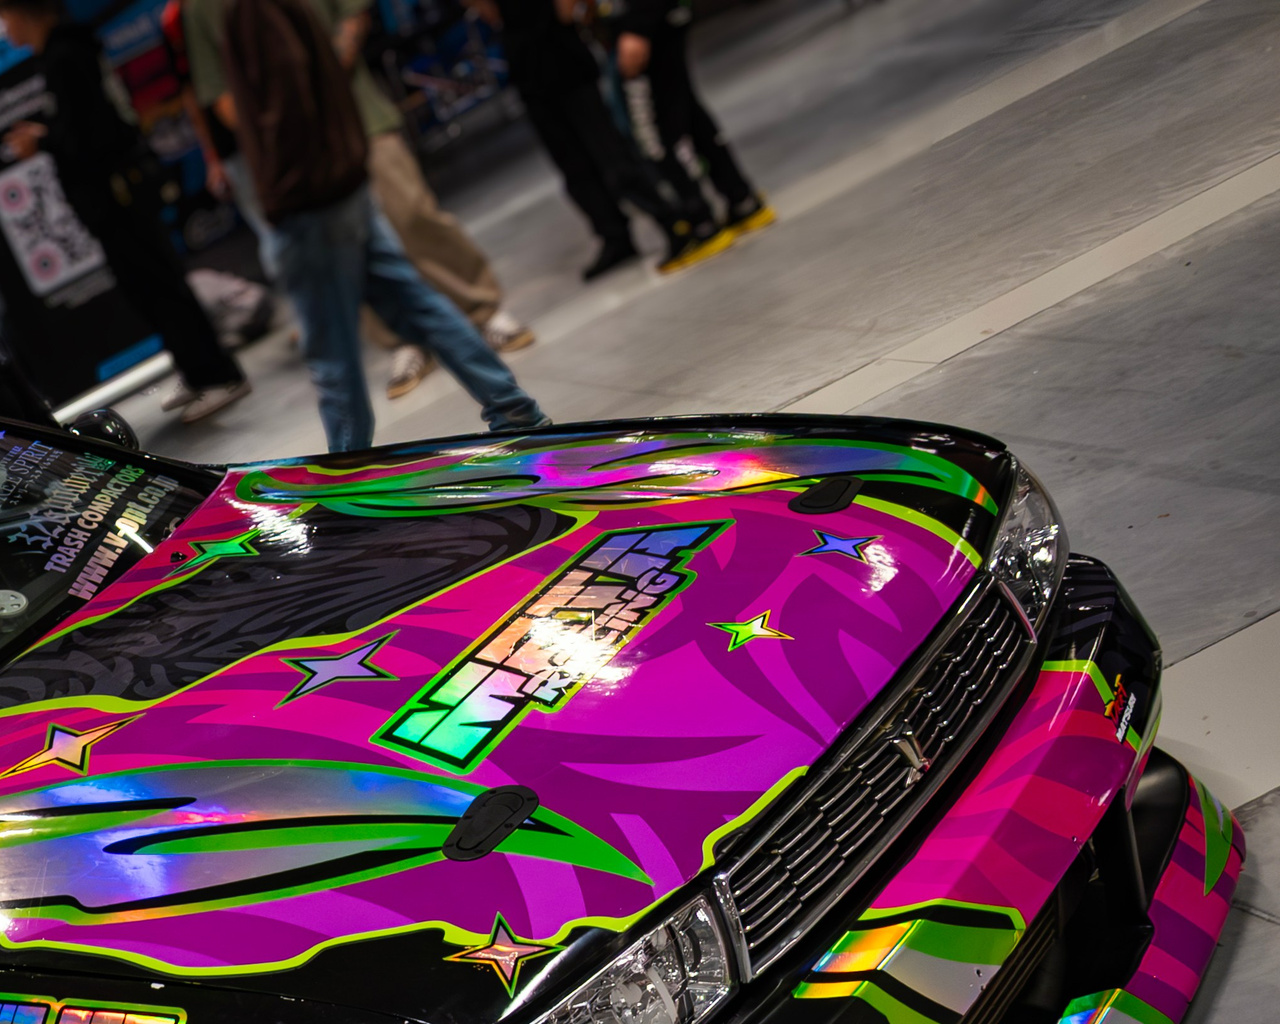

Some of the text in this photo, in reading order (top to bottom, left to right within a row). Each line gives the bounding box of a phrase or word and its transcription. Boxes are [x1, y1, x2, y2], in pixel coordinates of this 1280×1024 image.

[13, 440, 54, 475] SPIRIT
[44, 464, 145, 573] TRASH COMPACTORS
